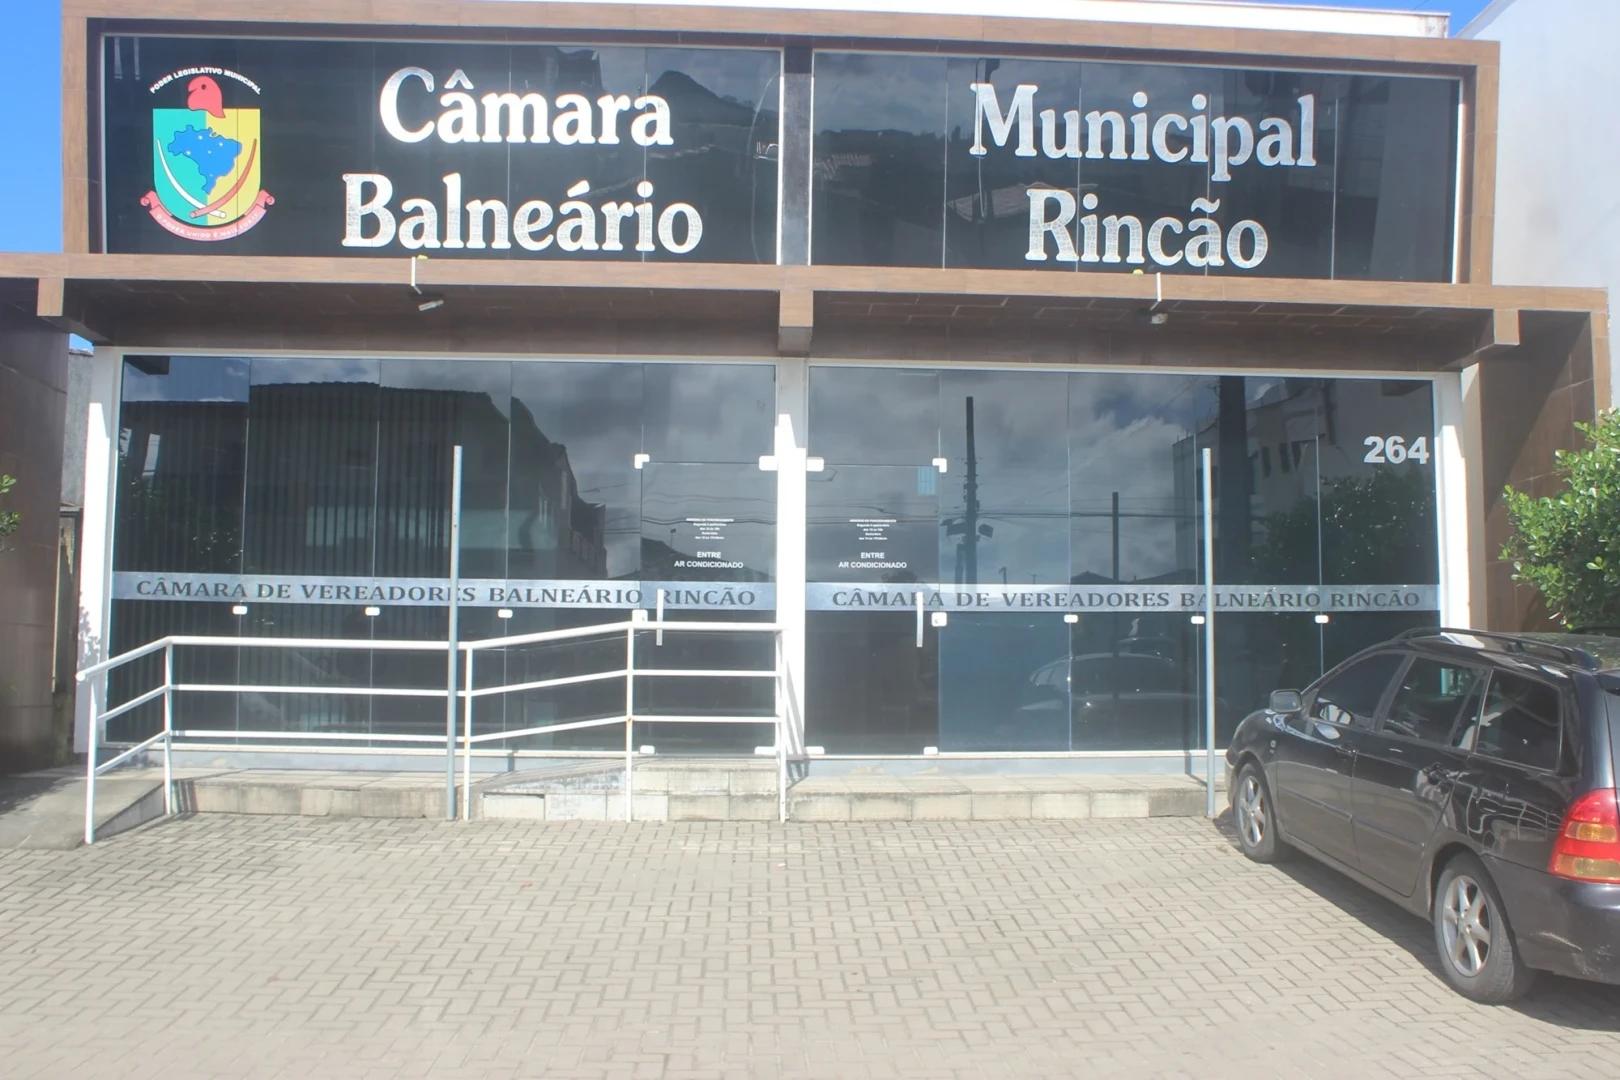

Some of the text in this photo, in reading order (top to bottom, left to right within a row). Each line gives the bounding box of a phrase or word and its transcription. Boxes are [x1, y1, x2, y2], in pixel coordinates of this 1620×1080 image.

[150, 66, 261, 95] PODER LEGISLATIVO MUNICIPAL
[379, 66, 1317, 183] Câmara Municipal
[341, 172, 1269, 270] Balneário Rincão
[1363, 435, 1430, 464] 264
[673, 560, 744, 569] AR CONDICIONADO
[696, 551, 722, 559] ENTRE
[838, 561, 908, 569] AR CONDICIONADO
[136, 577, 248, 598] CÂMARA
[256, 583, 291, 599] DE
[488, 584, 643, 605] BALNEÁRIO
[956, 592, 990, 607] DE
[1002, 592, 1169, 608] VEREADORES
[1330, 589, 1420, 607] RINCÃO
